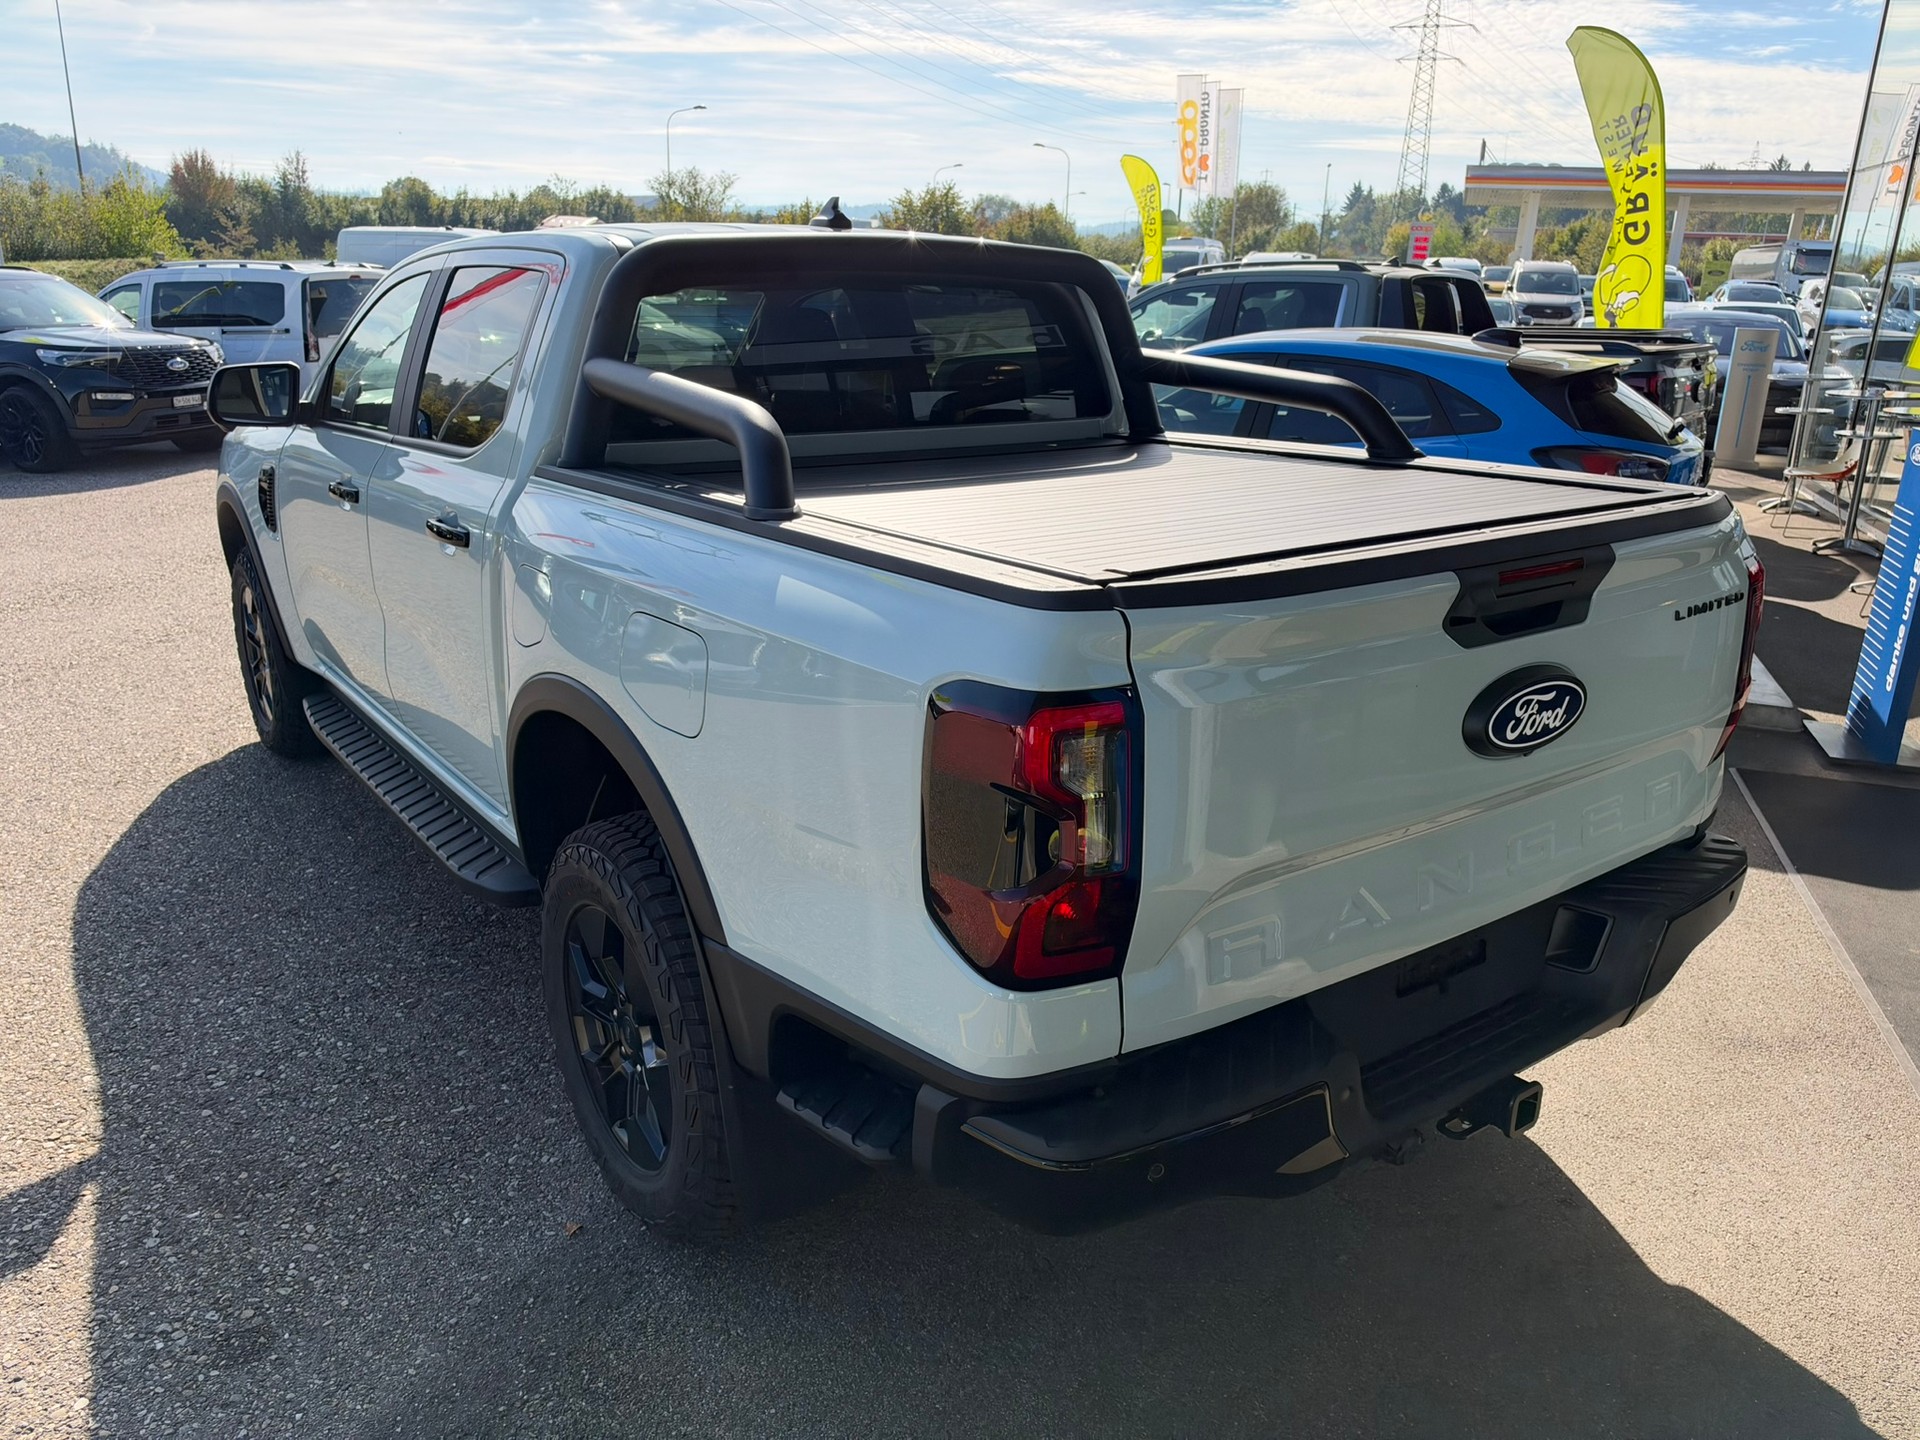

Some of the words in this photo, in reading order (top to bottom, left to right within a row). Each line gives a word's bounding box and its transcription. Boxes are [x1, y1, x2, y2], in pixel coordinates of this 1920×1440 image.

[1674, 592, 1745, 621] LIMITED
[1886, 623, 1906, 692] danke
[1902, 576, 1917, 621] und
[1506, 690, 1570, 741] Ford
[1206, 773, 1682, 985] RANGER
